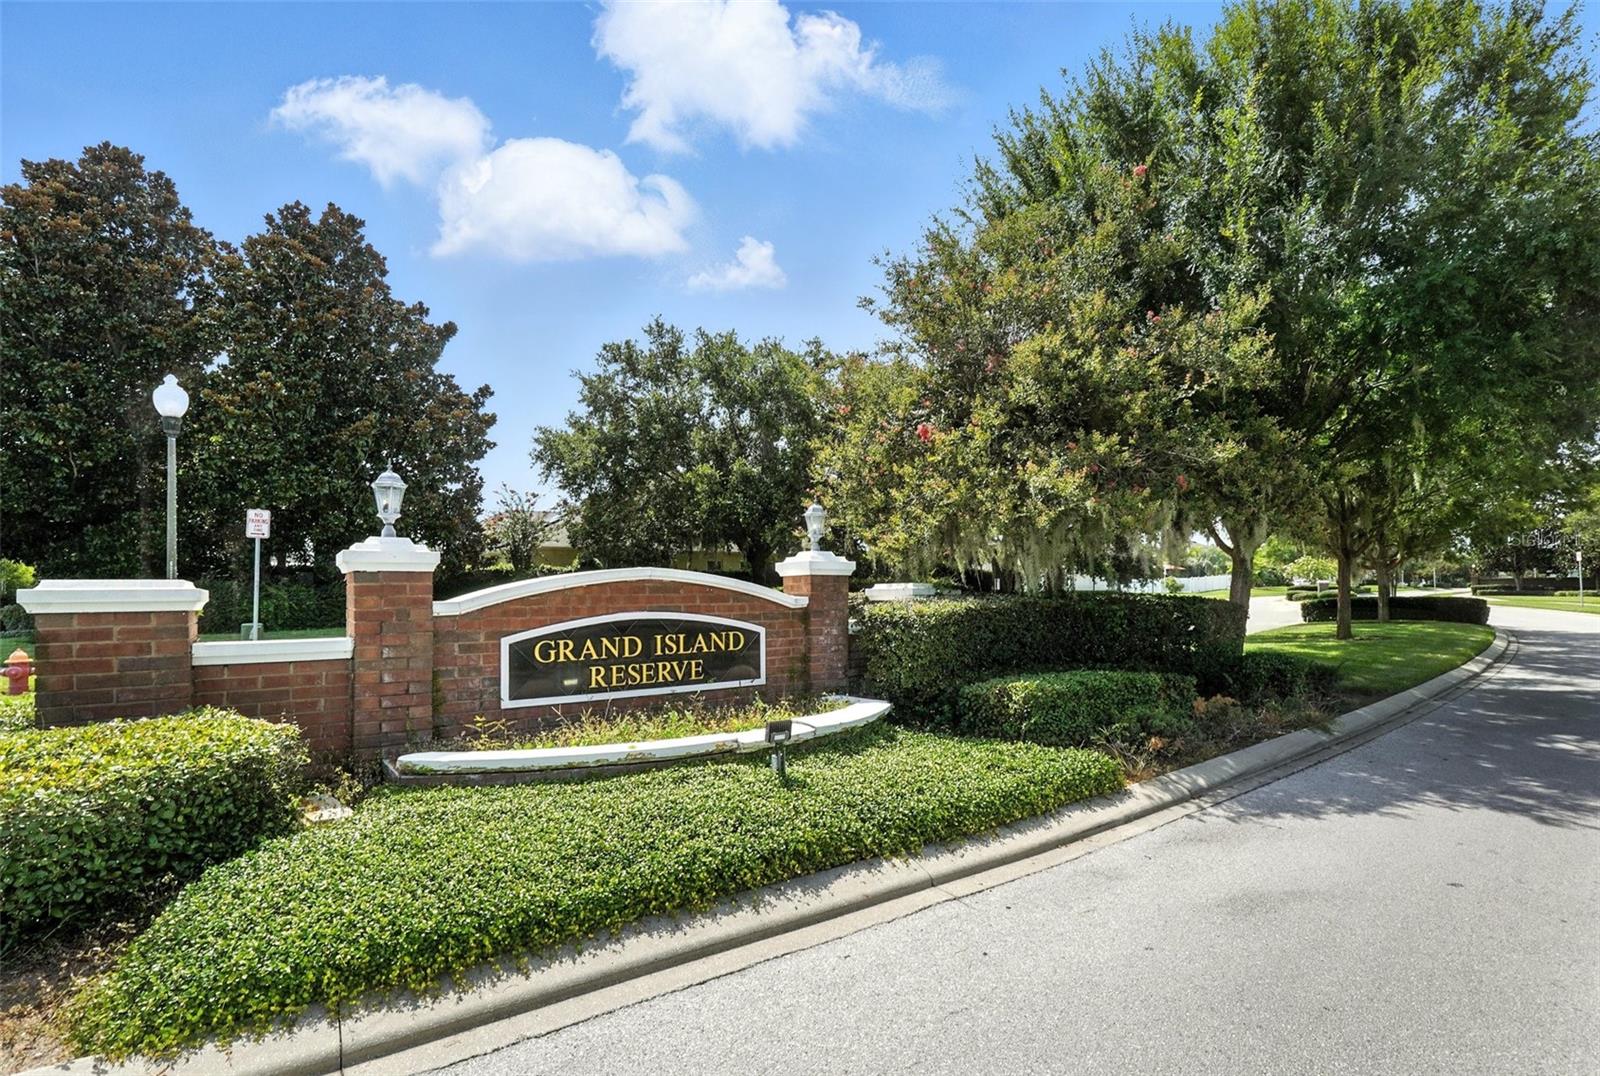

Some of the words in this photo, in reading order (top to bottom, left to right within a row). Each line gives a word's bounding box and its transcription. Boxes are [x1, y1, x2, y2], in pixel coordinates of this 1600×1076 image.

[533, 635, 643, 664] GRAND
[653, 631, 746, 656] ISLAND
[588, 659, 705, 689] RESERVE
